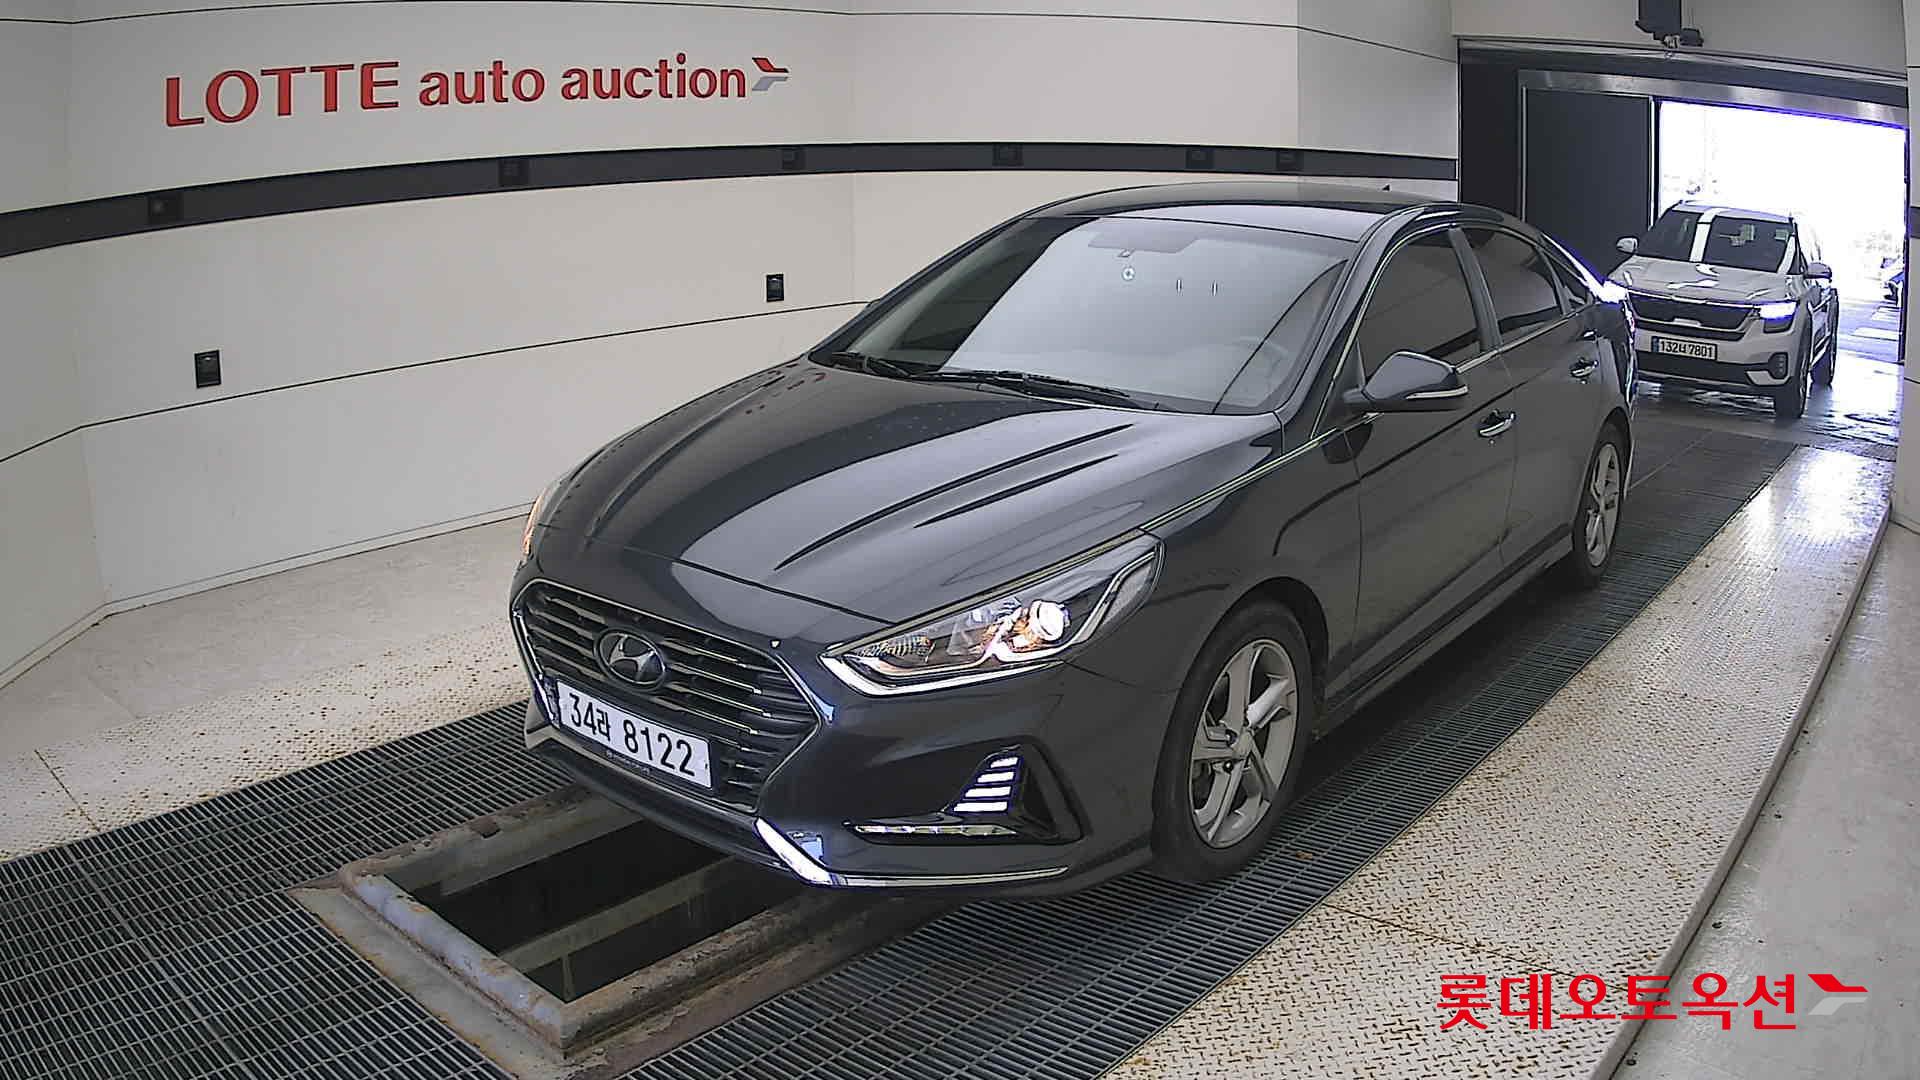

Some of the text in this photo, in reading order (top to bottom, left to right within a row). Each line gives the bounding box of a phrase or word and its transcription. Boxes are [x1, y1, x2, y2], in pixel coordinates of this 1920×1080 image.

[166, 53, 747, 127] LOTTE auto auction
[1688, 343, 1713, 358] 7801
[569, 692, 611, 742] 34라
[622, 719, 695, 777] 8122
